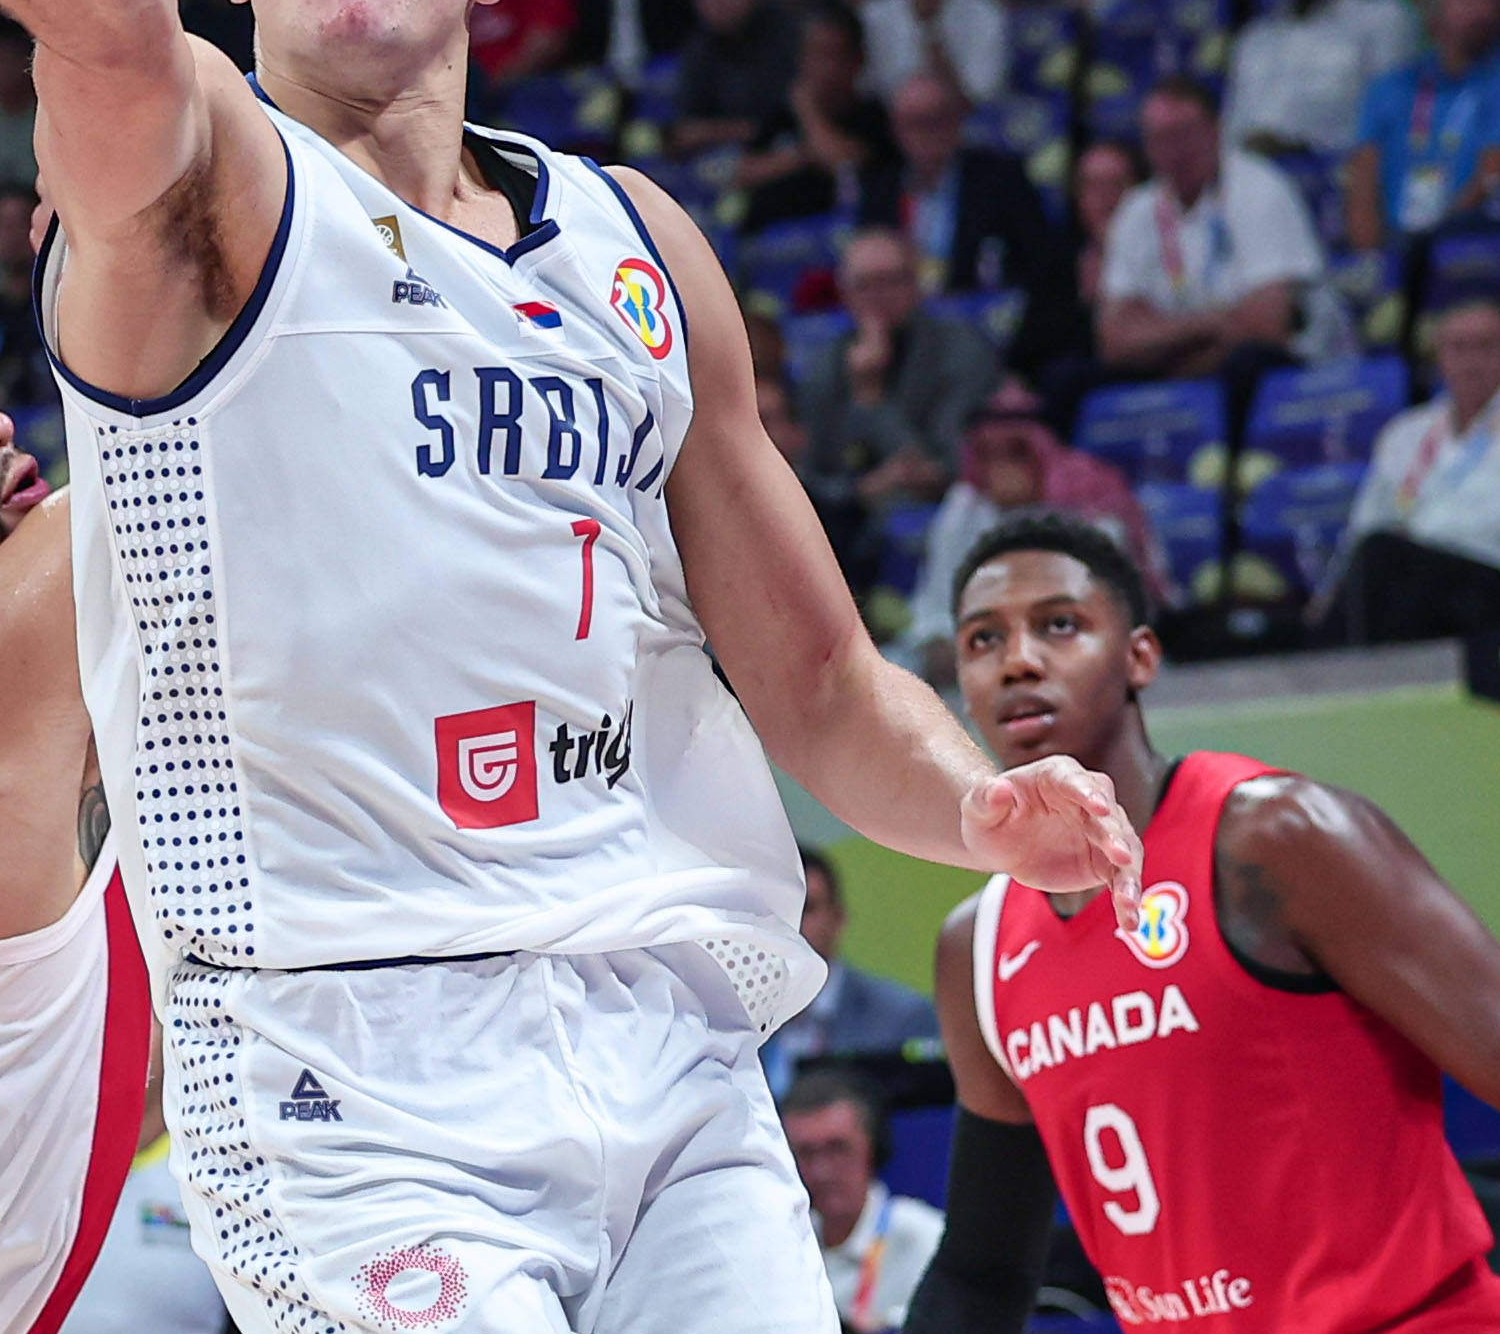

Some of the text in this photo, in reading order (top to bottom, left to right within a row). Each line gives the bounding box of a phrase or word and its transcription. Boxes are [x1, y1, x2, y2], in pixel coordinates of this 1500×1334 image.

[571, 518, 601, 641] 7
[1007, 984, 1200, 1081] CANADA
[279, 1098, 343, 1122] PEAK
[1083, 1103, 1161, 1236] 9
[1136, 1269, 1254, 1323] Sun Life
